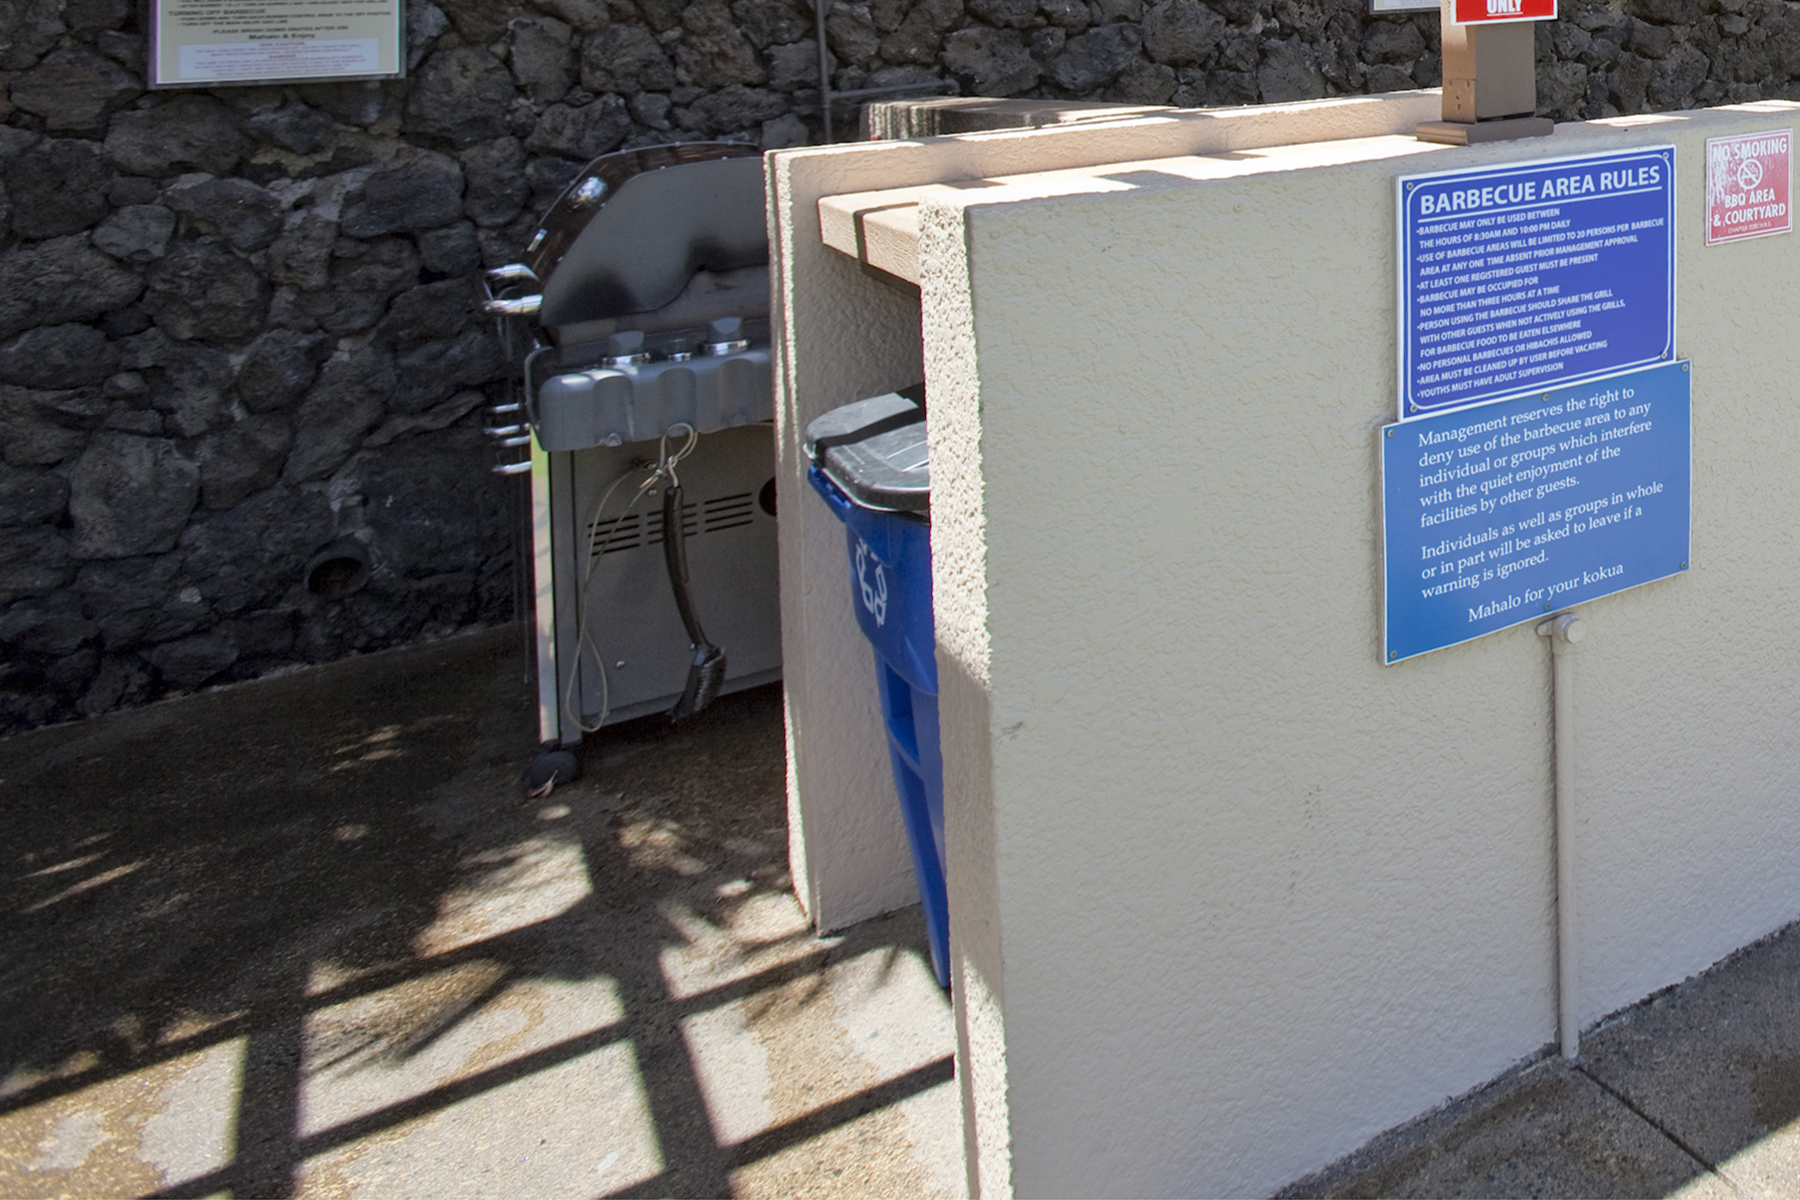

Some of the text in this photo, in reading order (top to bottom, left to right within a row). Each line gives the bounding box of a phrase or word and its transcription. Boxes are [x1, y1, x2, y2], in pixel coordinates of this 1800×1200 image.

[1713, 137, 1788, 162] NO SMOKING
[1421, 165, 1660, 215] BARBECUE AREA RULES
[1725, 188, 1775, 208] BBQ AREA
[1419, 208, 1560, 236] BARBECUE MAY ONLY BE USED BETWEEN
[1419, 219, 1571, 249] THE HOURS OF 8:30AM AND 10:00 PM DAILY
[1713, 203, 1786, 227] & COURTYARD
[1419, 253, 1598, 290] AT LEAST ONE REGISTERED GUEST MUST BE PRESENT
[1419, 276, 1539, 304] BARBECUE MAY BE OCCUPIED FOR
[1420, 285, 1560, 317] NO MORE THAN THREE HOURS AT A TIME
[1419, 330, 1593, 371] NO PERSONAL BARBECUES OR HIBACHIS ALLOWED
[1420, 362, 1564, 398] YOUTHS MUST HAVE ADULT SUPERVISION
[1418, 388, 1635, 447] Management reserves the right to
[1419, 403, 1651, 467] deny use of the barbecue area to any
[1420, 421, 1652, 487] individual or groups which interfere
[1420, 446, 1621, 507] with the quiet enjoyment of the
[1421, 476, 1579, 528] facilities by other guests.
[1422, 481, 1663, 559] Individuals as well as groups in whole
[1421, 505, 1642, 579] or in part will be asked to leave if a
[1422, 550, 1549, 598] warning is ignored.
[1469, 564, 1623, 622] Mahalo for your kokua
